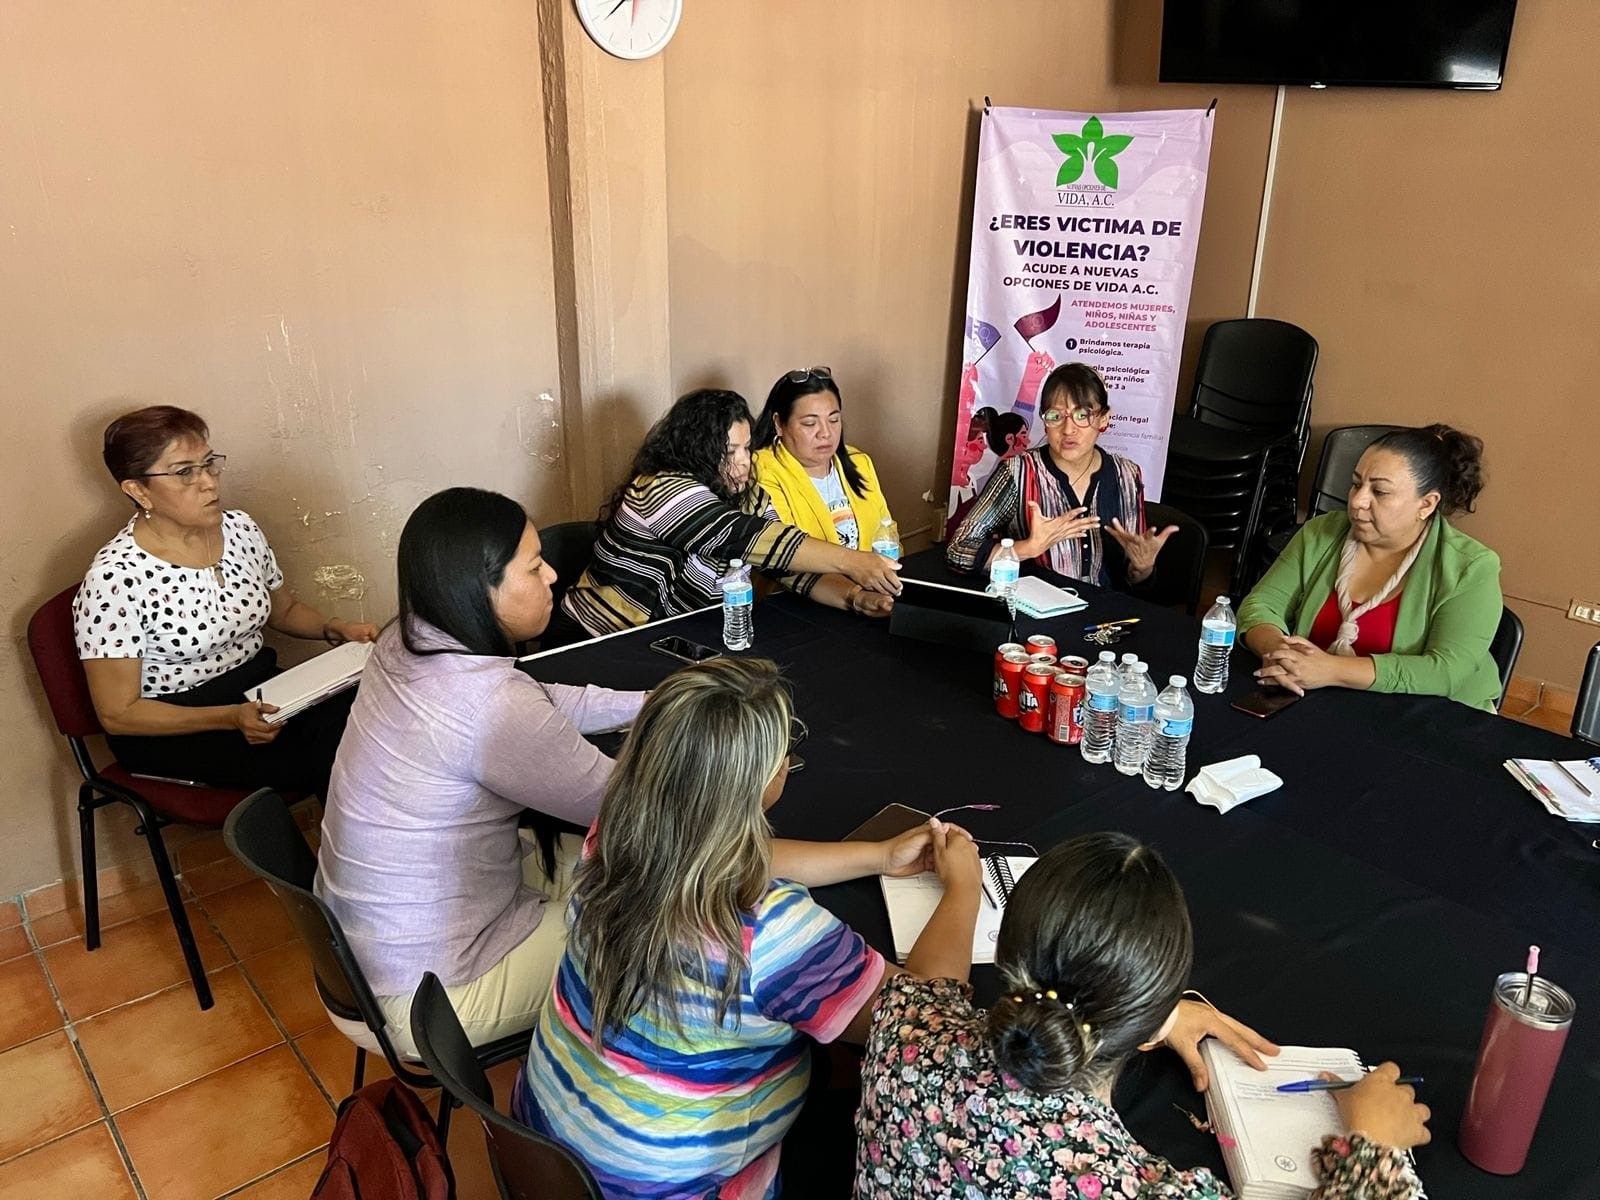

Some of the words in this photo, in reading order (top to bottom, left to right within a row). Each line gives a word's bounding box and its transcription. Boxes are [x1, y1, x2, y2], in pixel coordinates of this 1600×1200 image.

[1058, 192, 1089, 206] VIDA,
[1092, 193, 1115, 206] A.C.
[989, 215, 1051, 231] ¿ERES
[1057, 217, 1145, 235] VICTIMA
[1151, 220, 1182, 236] DE
[1014, 240, 1150, 262] VIOLENCIA?
[1022, 263, 1067, 275] ACUDE
[1070, 265, 1080, 276] A
[1084, 266, 1139, 278] NUEVAS
[1003, 276, 1070, 290] OPCIONES
[1073, 280, 1092, 291] DE
[1095, 281, 1128, 294] VIDA
[1132, 283, 1159, 295] A.C.
[1071, 300, 1128, 309] ATENDEMOS
[1130, 303, 1176, 314] MUJERES,
[1085, 310, 1117, 321] NIÑOS,
[1119, 312, 1147, 321] NIÑAS
[1084, 321, 1157, 332] ADOLESCENTES
[1080, 339, 1121, 347] Brindamos
[1123, 342, 1150, 350] terapia
[1079, 348, 1124, 356] psicológica.
[1106, 365, 1150, 375] psicológica
